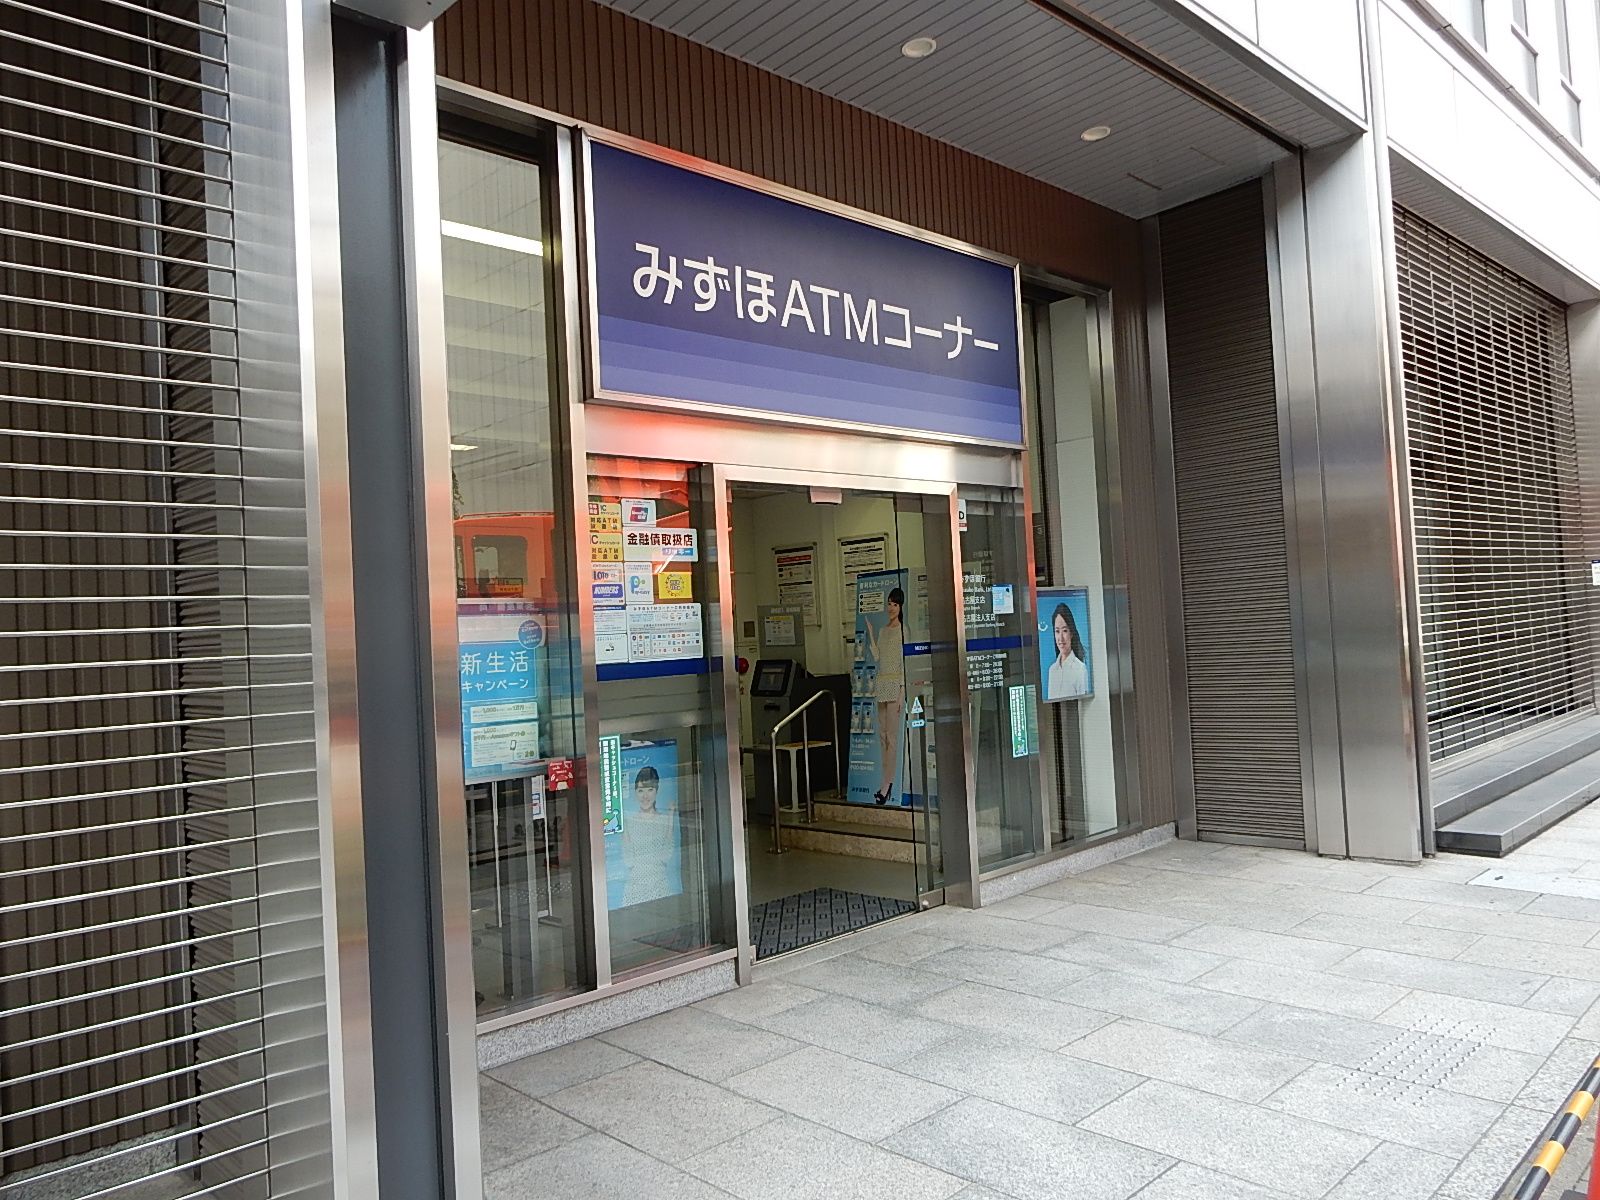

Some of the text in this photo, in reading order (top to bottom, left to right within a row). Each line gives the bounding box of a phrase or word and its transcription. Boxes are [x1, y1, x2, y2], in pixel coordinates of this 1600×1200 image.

[633, 243, 999, 359] みずほATMコーナー
[627, 533, 693, 547] 金融債取扱店
[962, 574, 986, 584] ずほ銀行
[461, 650, 529, 676] 新生活
[462, 678, 529, 694] キャンペーン
